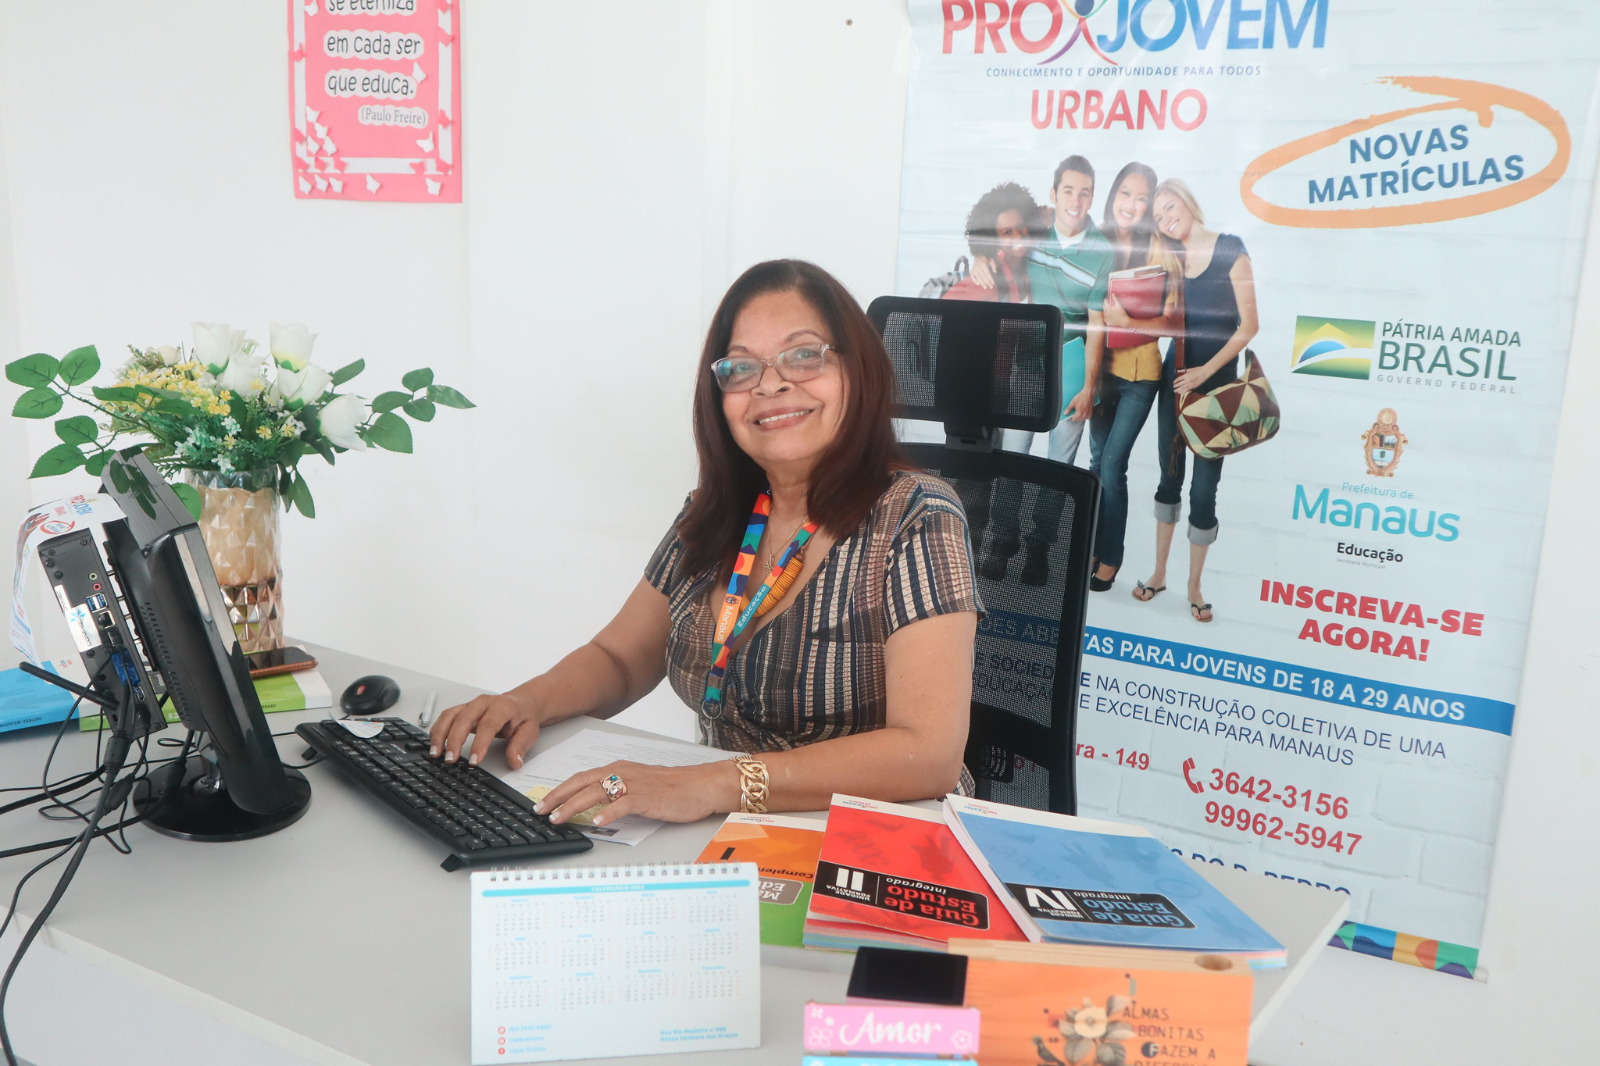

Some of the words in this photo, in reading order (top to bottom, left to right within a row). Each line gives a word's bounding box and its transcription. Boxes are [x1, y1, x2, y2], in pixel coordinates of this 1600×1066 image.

[328, 0, 344, 12] se
[327, 36, 349, 54] em
[396, 37, 420, 55] ser
[986, 67, 1074, 78] CONHECIMENTO
[1077, 67, 1084, 77] E
[1087, 66, 1179, 78] OPORTUNIDADE
[1183, 65, 1215, 77] PARA
[1219, 65, 1262, 76] TODOS
[327, 75, 357, 95] que
[360, 107, 391, 122] (Paulo
[393, 108, 427, 126] Freire)
[1030, 88, 1209, 132] URBANO
[1350, 124, 1470, 164] NOVAS
[1308, 154, 1525, 204] MATRÍCULAS
[1381, 318, 1445, 342] PÁTRIA
[1449, 326, 1522, 348] AMADA
[1377, 340, 1518, 382] BRASIL
[1377, 374, 1443, 388] GOVERNO
[1451, 380, 1517, 395] FEDERAL
[1341, 481, 1397, 498] Prefeitura
[1400, 488, 1415, 500] de
[1292, 484, 1461, 542] Manaus
[1336, 542, 1404, 563] Educação
[737, 585, 767, 628] Educação
[1259, 579, 1485, 637] INSCREVA-SE
[717, 605, 735, 642] Manaus
[1298, 618, 1430, 662] AGORA!
[1120, 640, 1175, 667] PARA
[1180, 653, 1267, 684] JOVENS
[1272, 669, 1304, 692] DE
[1311, 677, 1335, 699] 18
[1339, 683, 1356, 703] A
[1361, 688, 1389, 709] 29
[1394, 694, 1466, 721] ANOS
[1096, 674, 1121, 694] NA
[1125, 681, 1256, 721] CONSTRUÇÃO
[1262, 709, 1357, 743] COLETIVA
[1363, 730, 1392, 750] DE
[1399, 736, 1447, 759] UMA
[1096, 696, 1210, 735] EXCELÊNCIA
[1215, 721, 1265, 747] PARA
[1269, 732, 1354, 766] MANAUS
[1076, 743, 1095, 760] ra
[1115, 748, 1150, 771] 149
[1209, 768, 1349, 820] 3642-3156
[1204, 801, 1363, 855] 99962-5947
[826, 884, 871, 898] FORMATIVA
[835, 867, 865, 892] II
[886, 876, 948, 894] integrado
[758, 889, 781, 901] Ma
[834, 890, 871, 902] UNIDADE
[884, 897, 915, 914] de
[887, 884, 978, 914] Estudo
[1024, 887, 1076, 911] IV
[1073, 890, 1131, 901] integrado
[919, 903, 980, 927] Guia
[1086, 898, 1174, 917] Estudo
[1098, 910, 1125, 925] de
[1130, 913, 1185, 928] Guia
[1122, 1006, 1170, 1021] ALMAS
[839, 1011, 942, 1045] Amor
[1137, 1025, 1205, 1041] BONITAS
[1148, 1043, 1198, 1058] FAZEM
[1208, 1049, 1217, 1060] A
